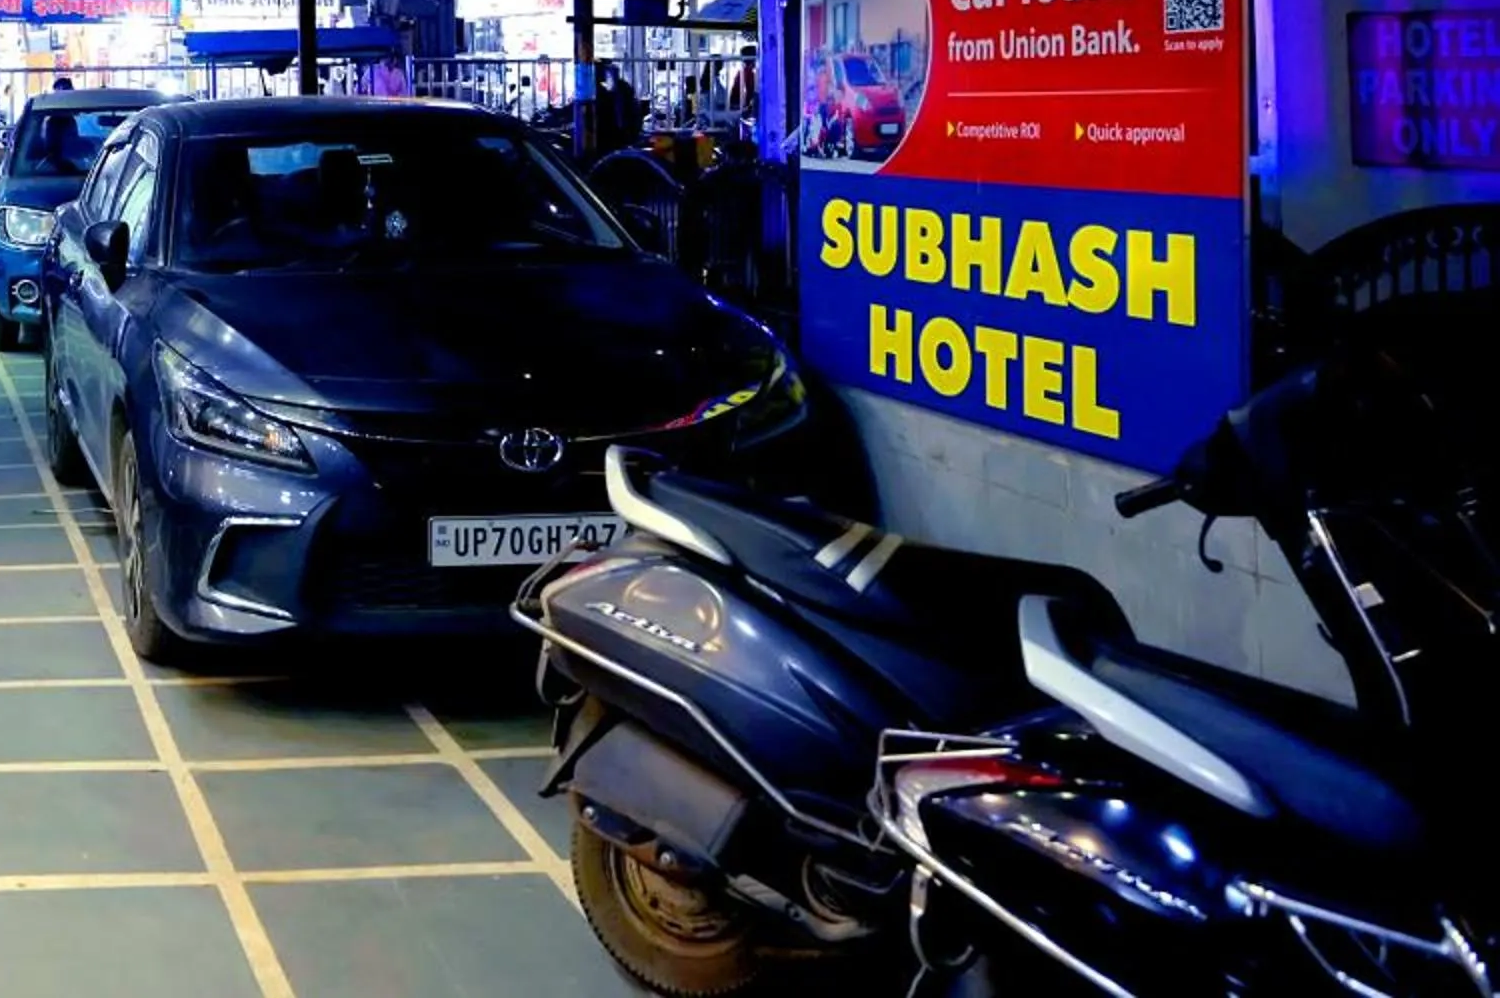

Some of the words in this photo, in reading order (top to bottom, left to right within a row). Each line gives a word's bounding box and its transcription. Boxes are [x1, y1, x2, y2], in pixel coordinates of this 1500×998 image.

[948, 31, 995, 62] from
[1000, 27, 1065, 59] Union
[1071, 19, 1140, 56] Bank.
[1164, 39, 1185, 51] Scan
[1186, 39, 1196, 50] to
[1197, 38, 1224, 51] apply
[1378, 18, 1500, 58] HOTEL
[956, 122, 1019, 141] Competitive
[1020, 122, 1040, 138] ROI
[1087, 121, 1122, 142] Quick
[1125, 123, 1185, 145] approval
[1392, 118, 1497, 157] ONLY
[820, 198, 1195, 326] SUBHASH
[869, 303, 1120, 439] HOTEL
